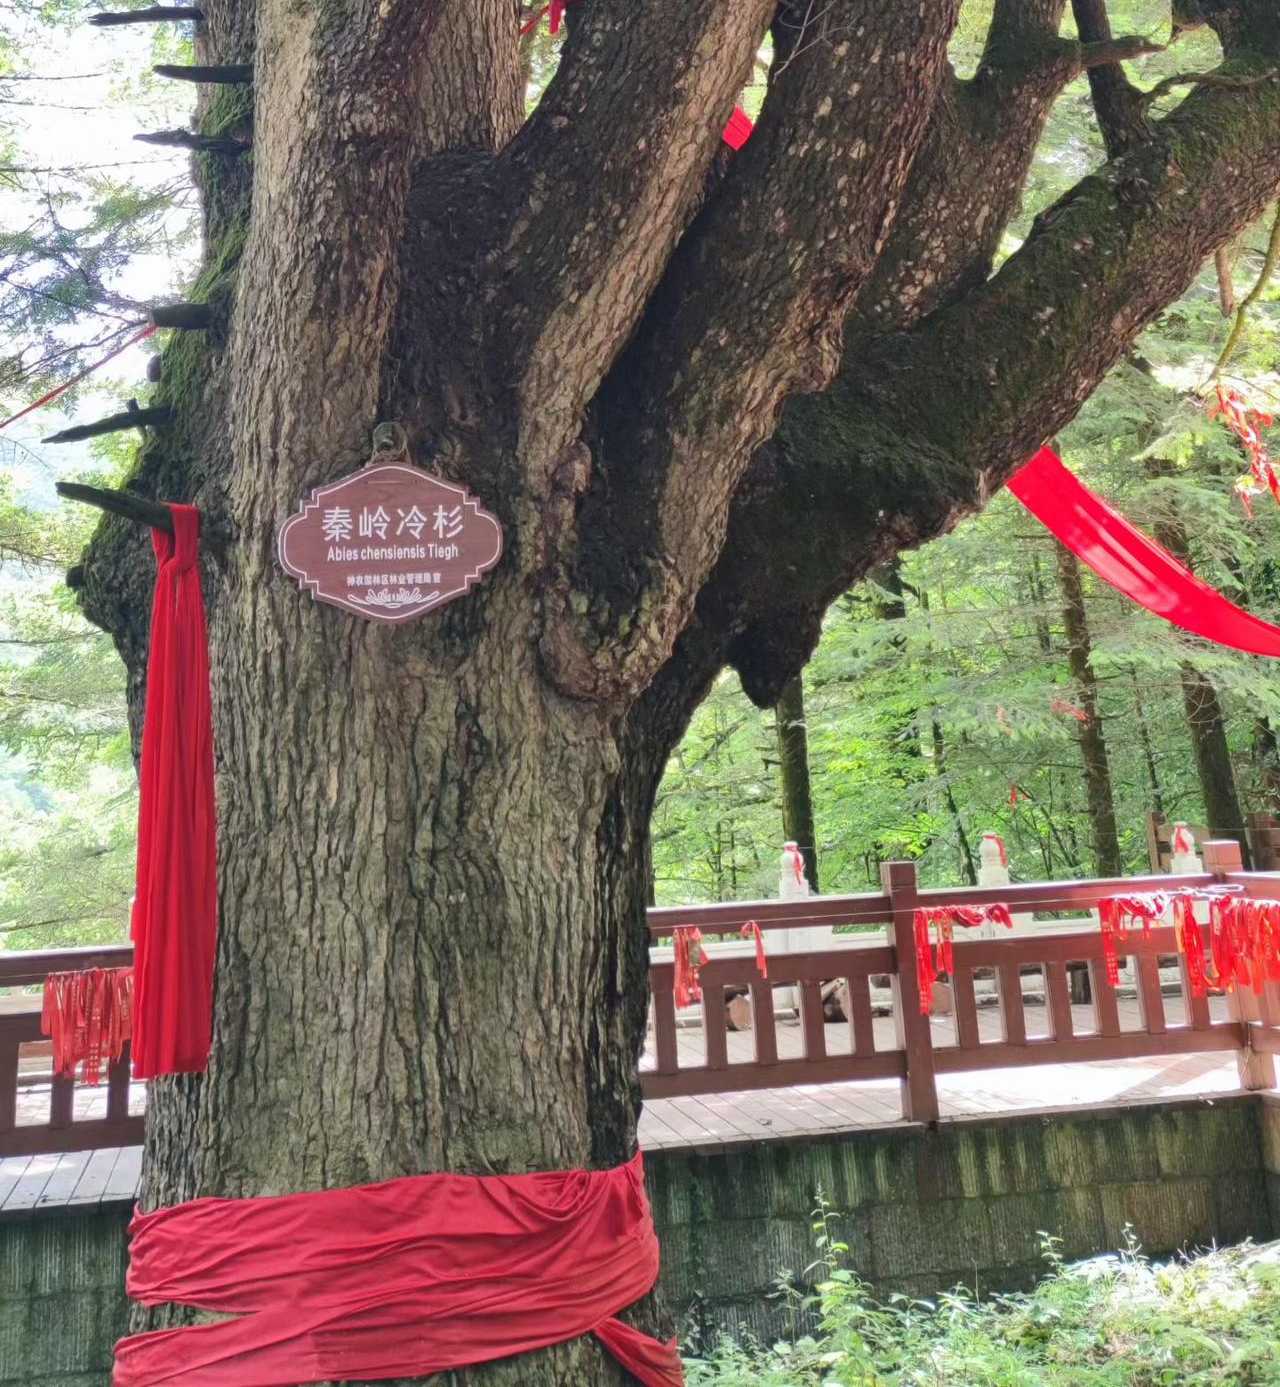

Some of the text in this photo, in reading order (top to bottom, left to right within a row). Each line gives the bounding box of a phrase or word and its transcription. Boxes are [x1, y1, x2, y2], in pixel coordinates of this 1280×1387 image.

[322, 505, 464, 542] 秦岭冷杉
[327, 543, 458, 562] Abies chensiensis Tiegh
